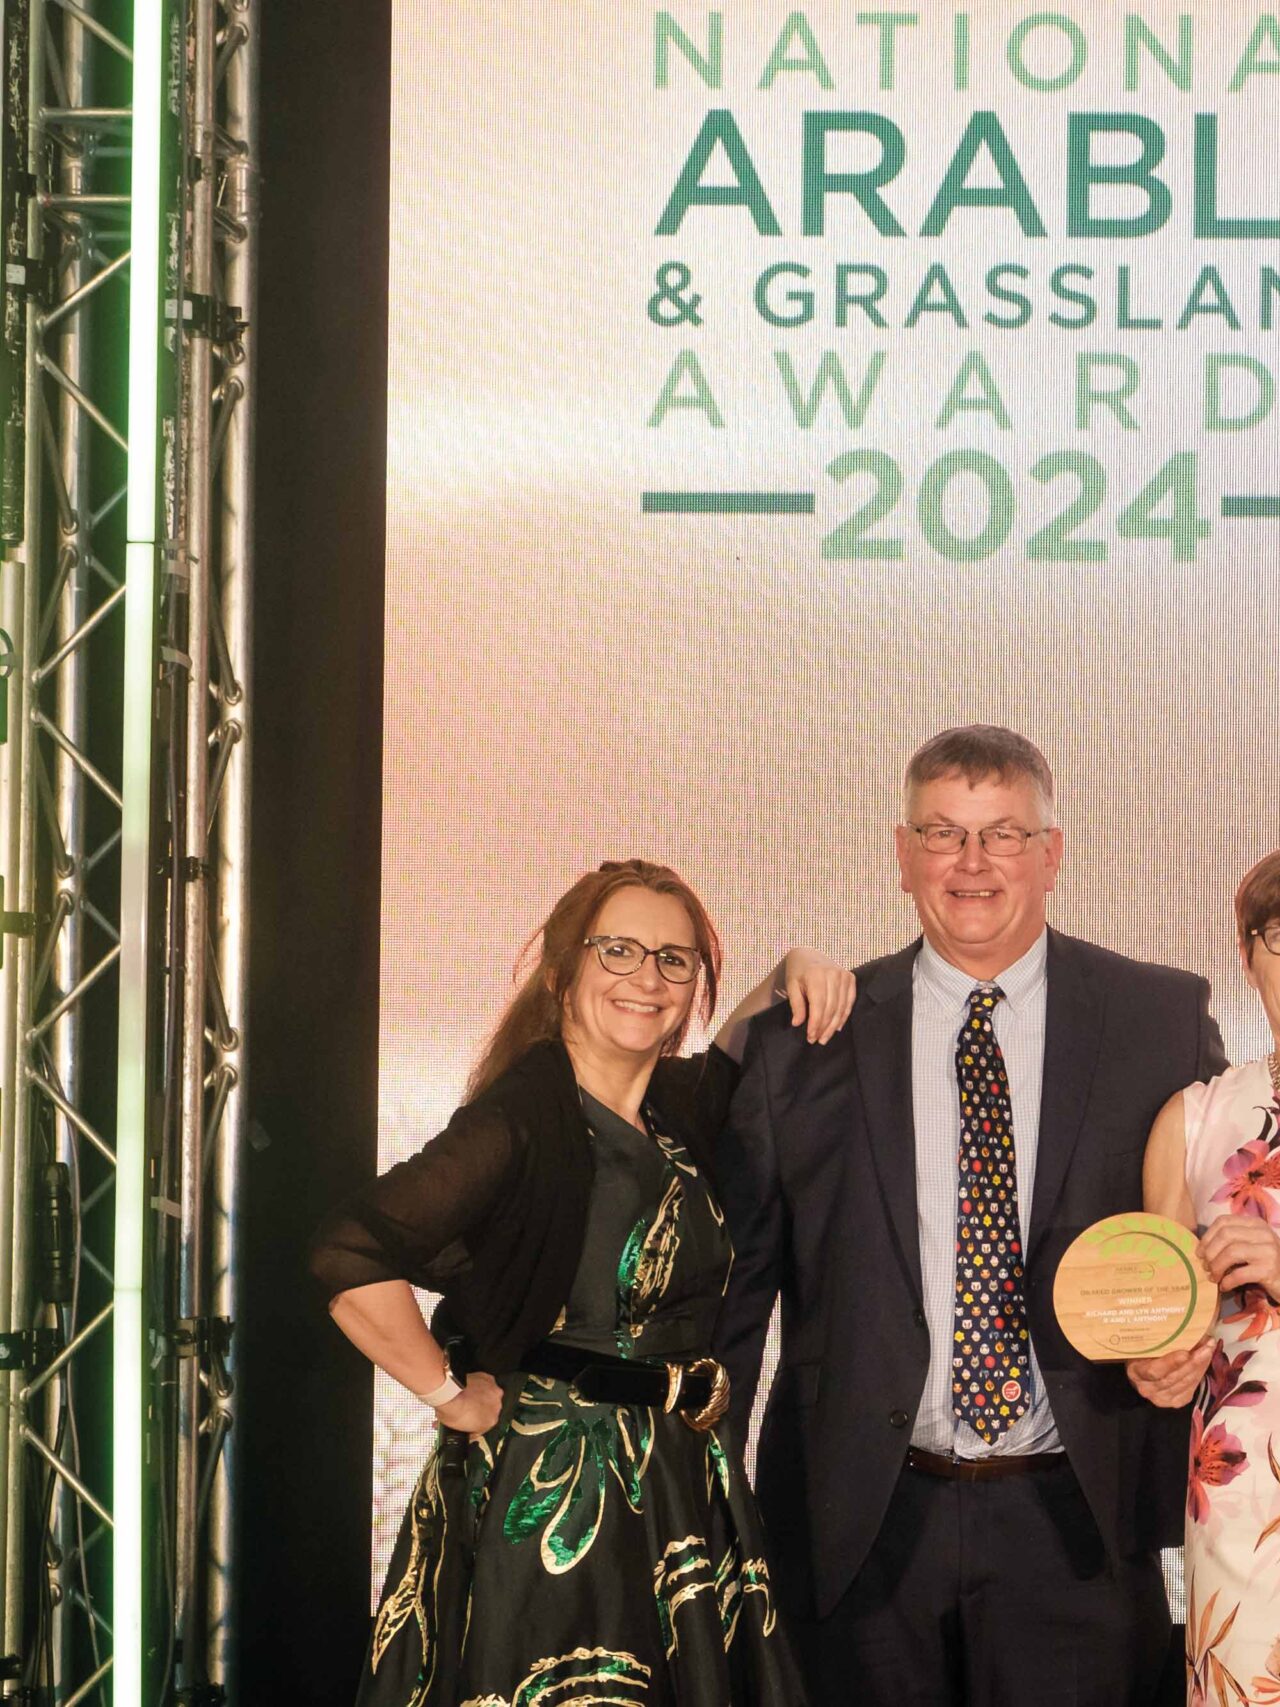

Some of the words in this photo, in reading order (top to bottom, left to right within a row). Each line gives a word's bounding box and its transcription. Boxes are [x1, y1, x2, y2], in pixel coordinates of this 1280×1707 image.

[646, 261, 704, 328] &
[820, 448, 1212, 564] 2024
[1119, 1296, 1152, 1305] WINNER
[1151, 1306, 1185, 1314] ANTHONY
[1134, 1315, 1168, 1323] ANTHONY
